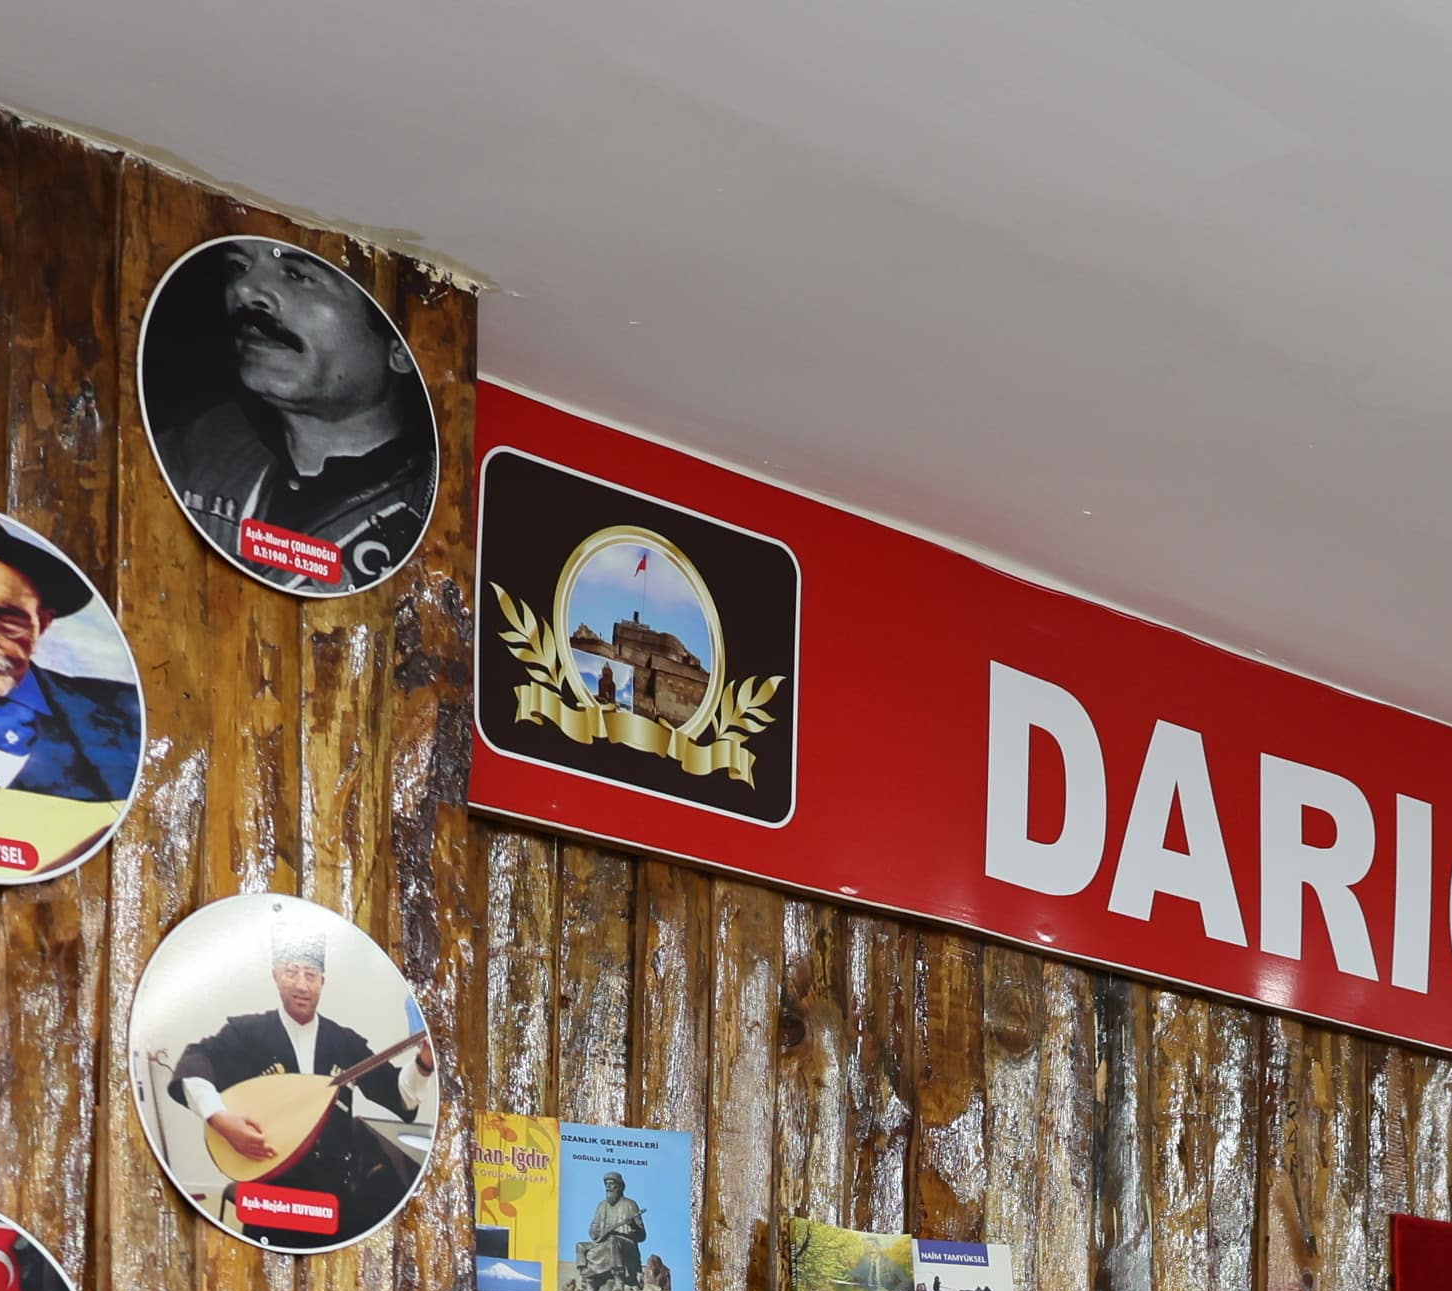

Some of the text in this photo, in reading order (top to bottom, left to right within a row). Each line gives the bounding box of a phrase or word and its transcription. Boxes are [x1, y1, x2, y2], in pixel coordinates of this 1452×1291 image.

[291, 540, 337, 563] ÇOBANOĞLU
[561, 1134, 659, 1149] OZANLIK GELENEKLERİ
[921, 1251, 987, 1264] NAİM TAMYÜKSEL
